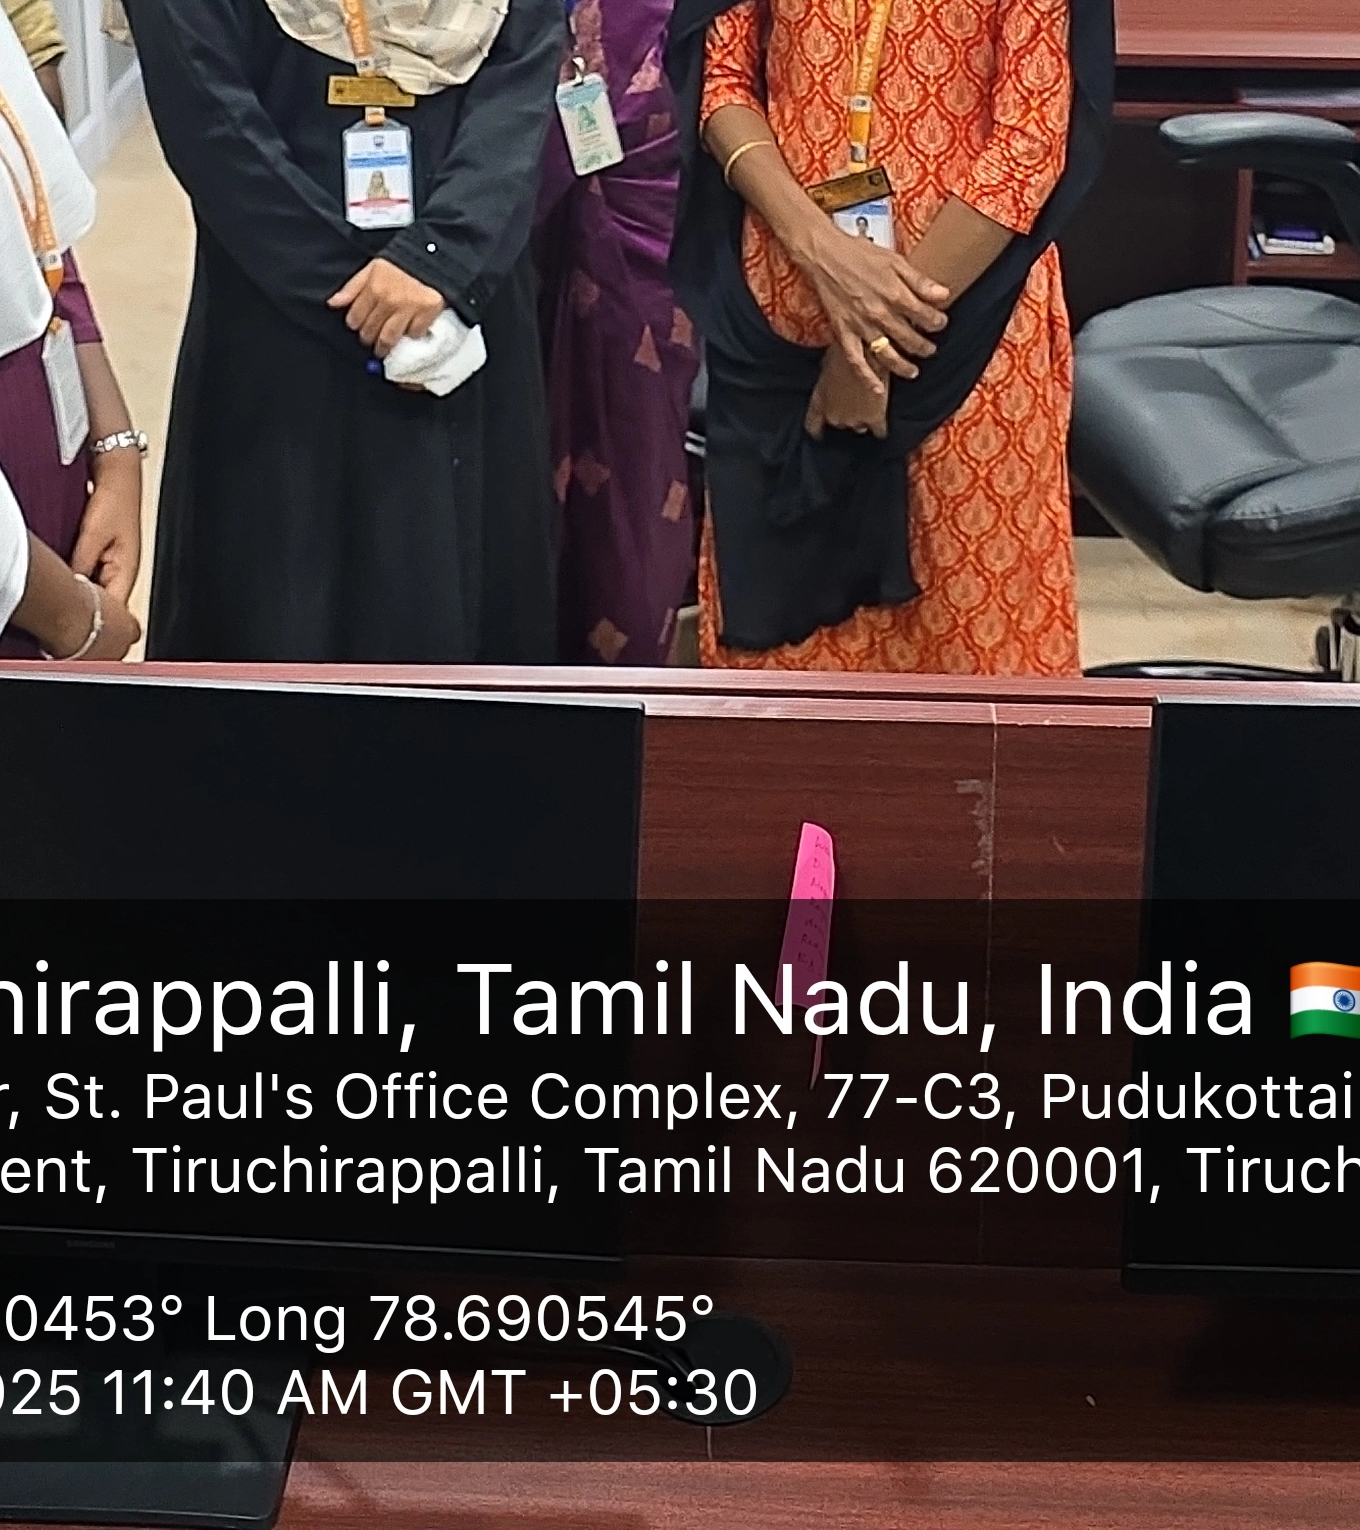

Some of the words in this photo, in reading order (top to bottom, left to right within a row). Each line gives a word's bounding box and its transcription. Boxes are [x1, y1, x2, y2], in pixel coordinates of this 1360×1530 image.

[348, 16, 366, 54] HOLY
[857, 55, 874, 92] HOLY
[866, 4, 886, 53] CROSS
